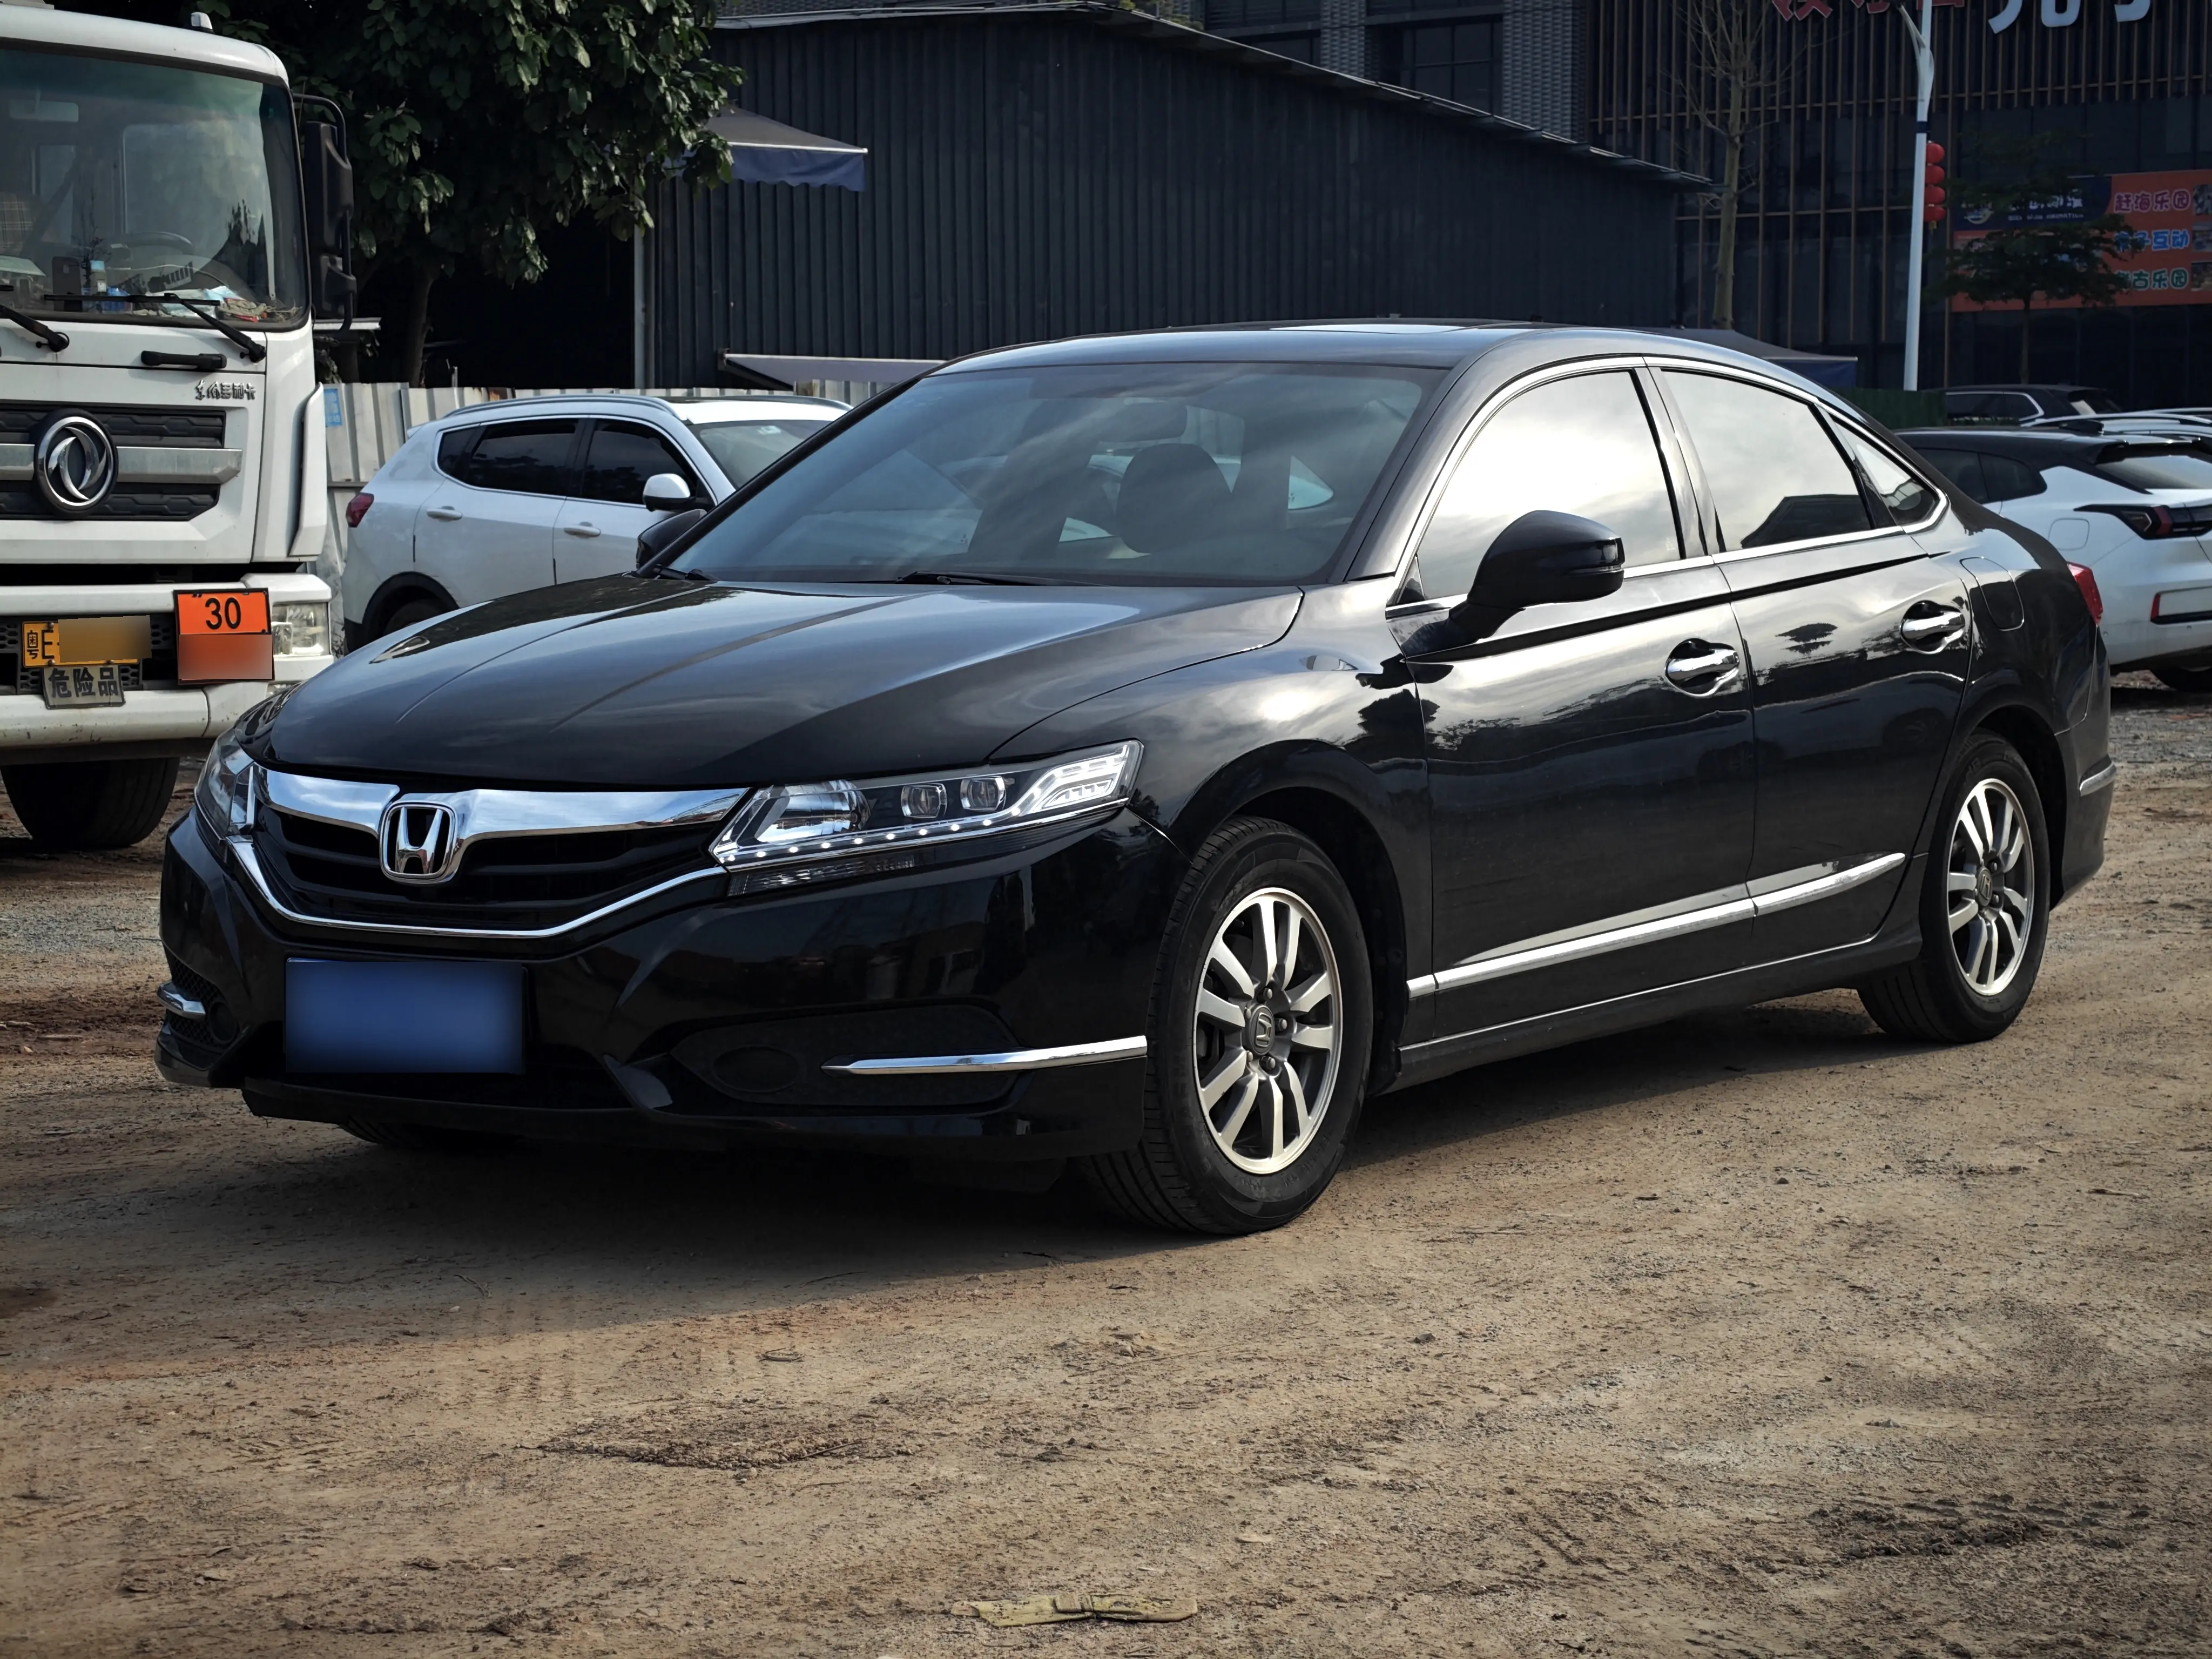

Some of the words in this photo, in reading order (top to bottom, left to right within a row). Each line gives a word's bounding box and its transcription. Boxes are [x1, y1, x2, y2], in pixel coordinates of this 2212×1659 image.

[2114, 189, 2190, 213] 赶海乐园
[205, 597, 241, 630] 30
[48, 667, 119, 698] 危险品
